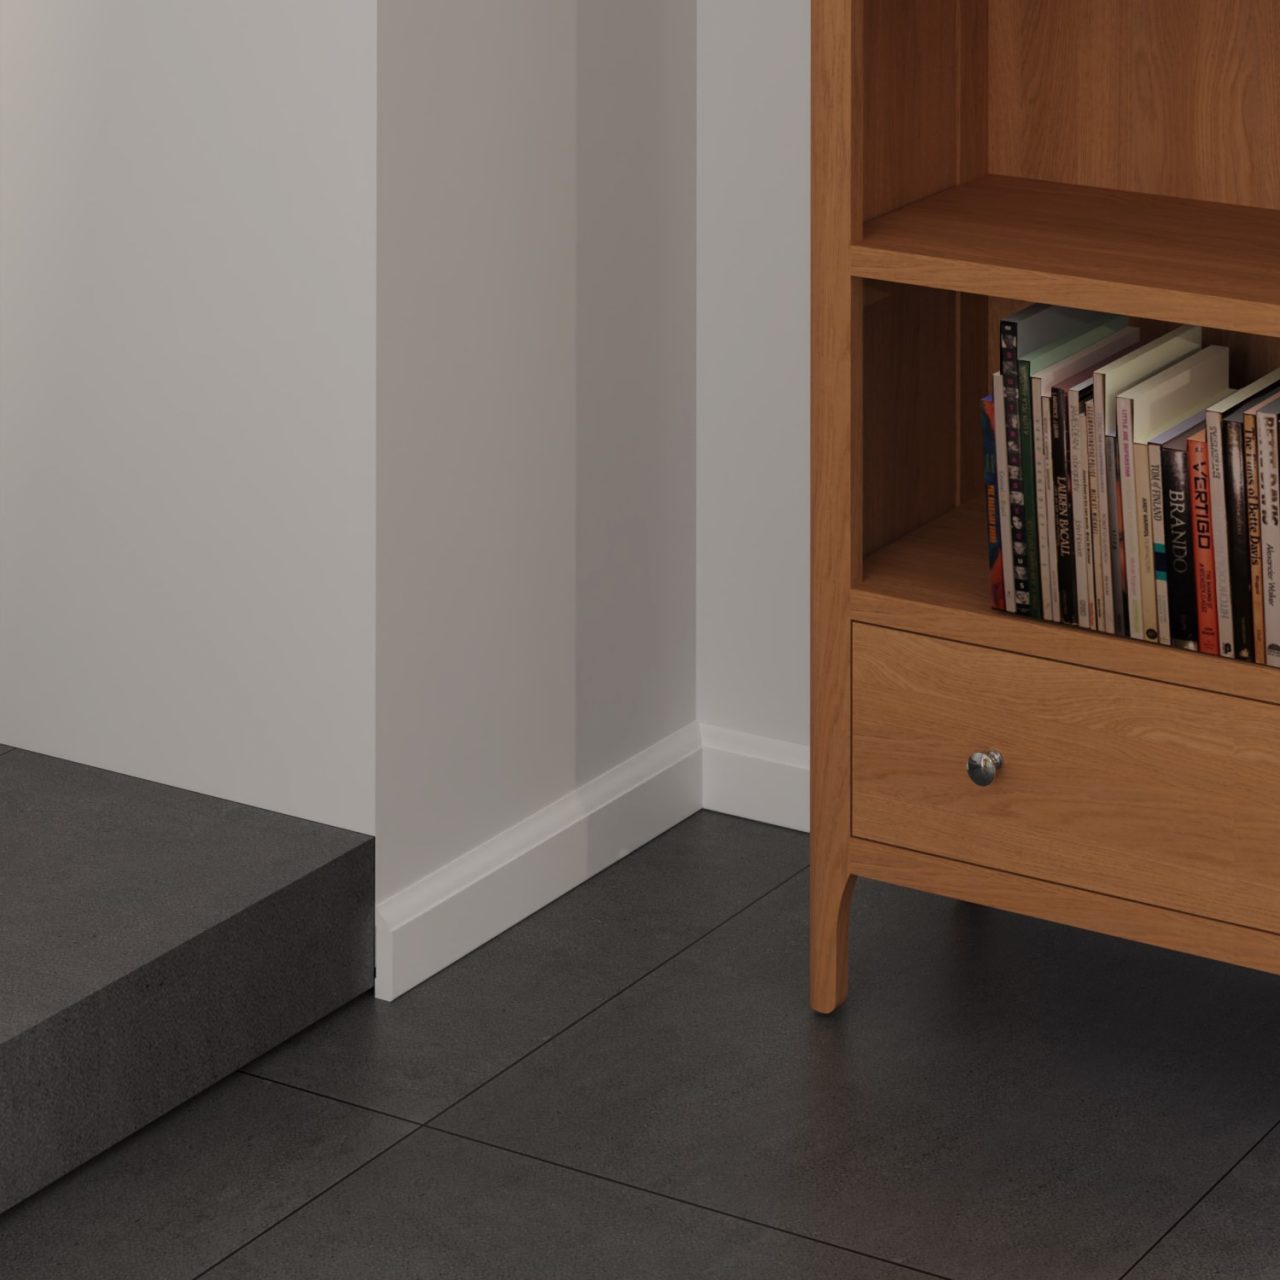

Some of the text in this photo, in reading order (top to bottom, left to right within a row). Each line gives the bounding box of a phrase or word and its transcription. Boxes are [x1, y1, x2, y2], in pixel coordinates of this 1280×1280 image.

[1151, 464, 1160, 481] TOM
[1152, 489, 1162, 521] FINLAND
[1193, 462, 1210, 549] VERTIGO
[1247, 488, 1260, 500] of
[1057, 476, 1070, 557] LAUREN BACALL
[1168, 489, 1188, 574] BRANDO
[1249, 502, 1260, 532] Bette
[1250, 535, 1261, 566] Davis
[1266, 543, 1277, 580] Alexander
